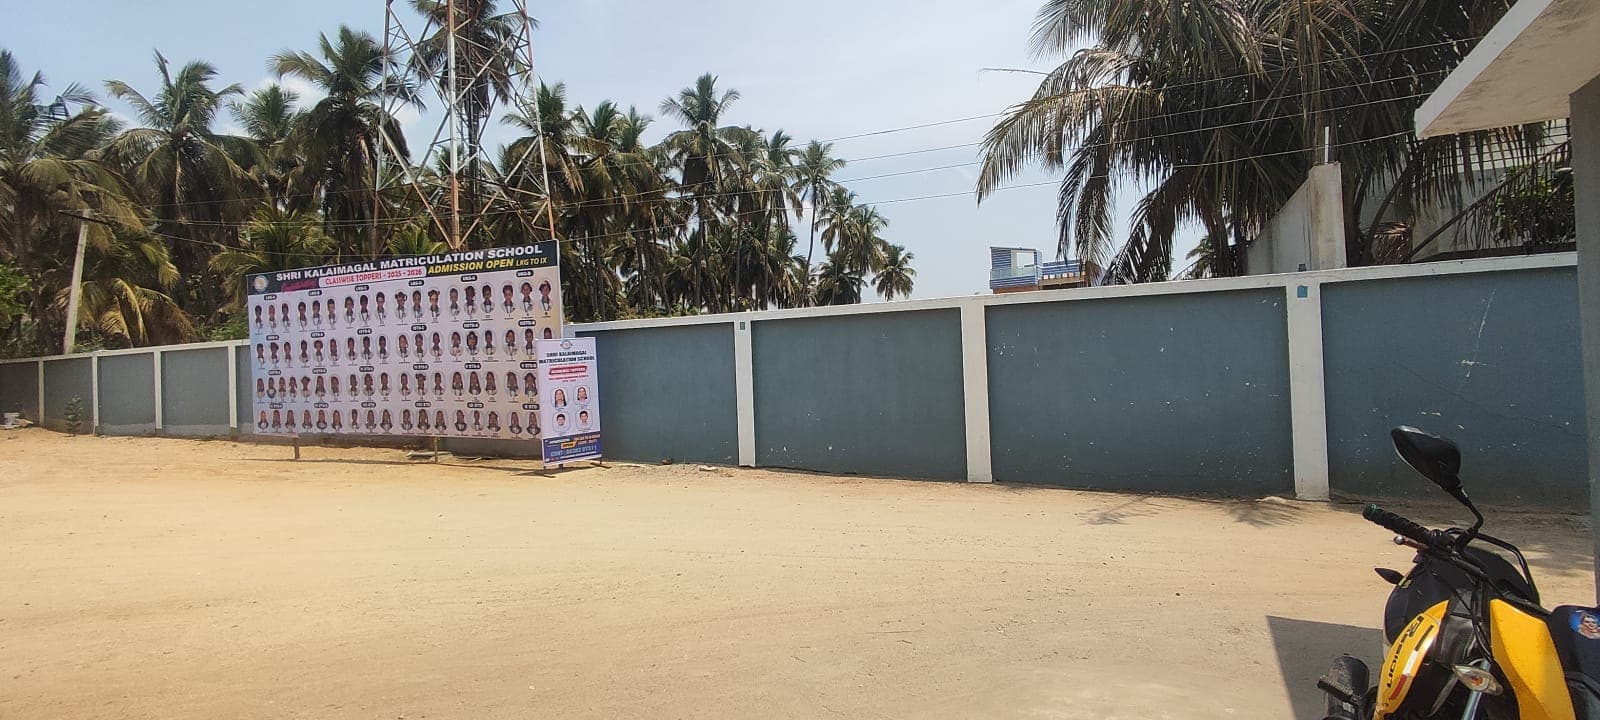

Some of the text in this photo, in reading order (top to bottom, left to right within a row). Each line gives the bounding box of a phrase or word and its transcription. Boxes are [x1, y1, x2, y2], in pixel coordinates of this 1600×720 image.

[276, 245, 543, 281] SHRI KALAIMAGAL MATRICULATION SCHOOL
[428, 256, 548, 274] ADMISSION OPEN LKG TO IX
